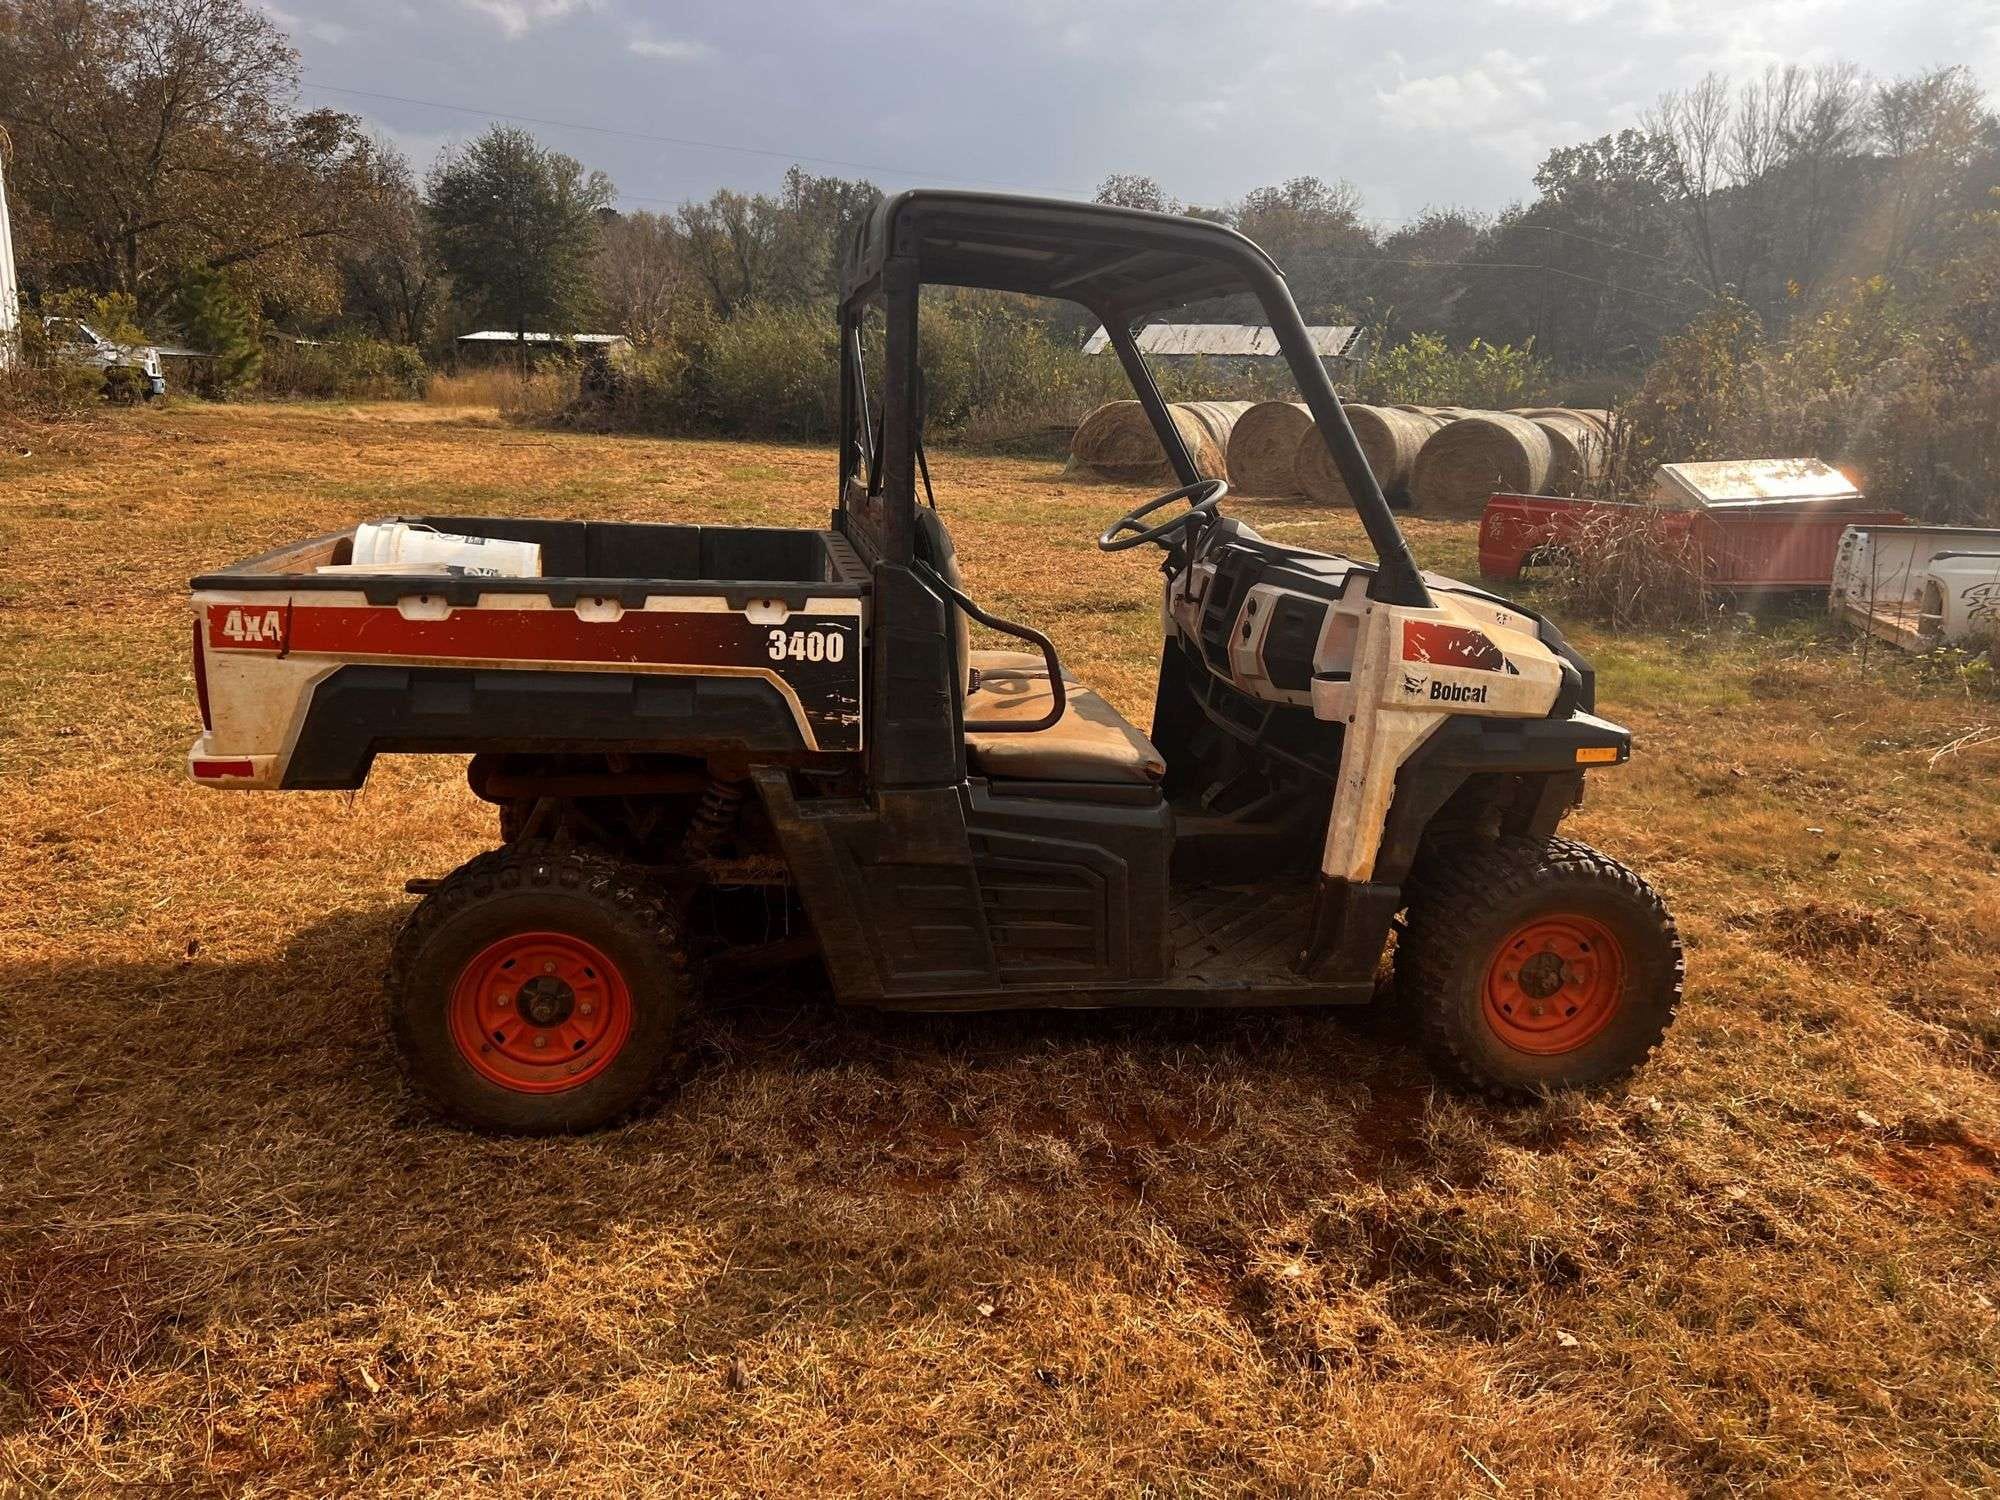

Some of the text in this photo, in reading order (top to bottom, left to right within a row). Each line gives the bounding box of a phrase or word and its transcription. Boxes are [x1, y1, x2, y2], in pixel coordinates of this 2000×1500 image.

[222, 610, 283, 642] 4x4
[768, 629, 844, 663] 3400
[1429, 680, 1487, 703] Bobcat
